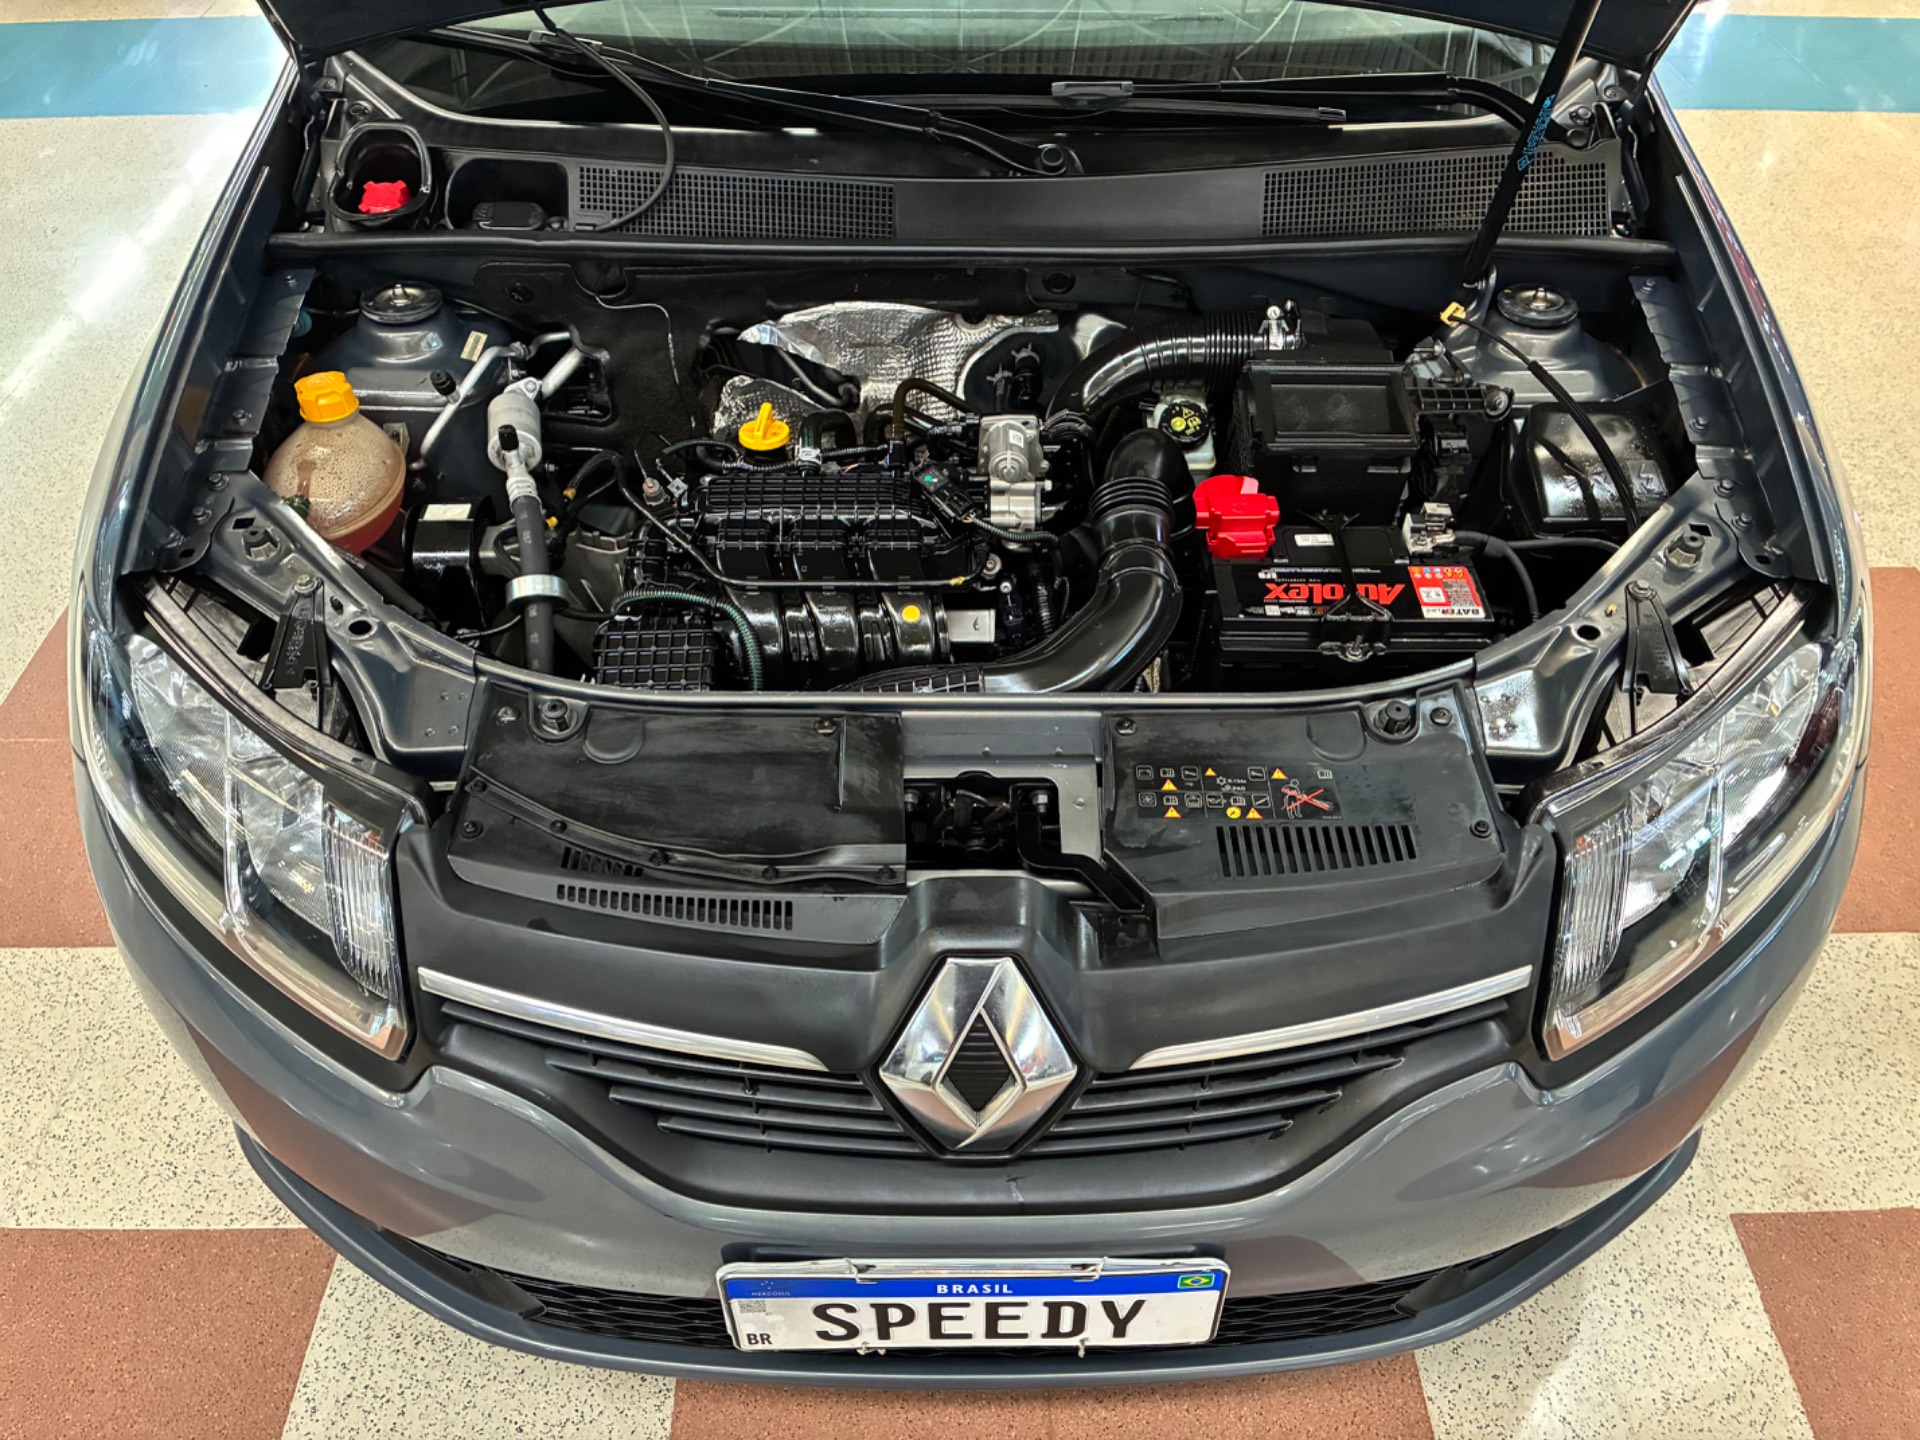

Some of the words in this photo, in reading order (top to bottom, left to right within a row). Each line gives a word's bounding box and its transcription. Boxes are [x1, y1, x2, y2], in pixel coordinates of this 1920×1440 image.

[937, 1283, 1013, 1295] BRASIL
[812, 1299, 1147, 1343] SPEEDY
[745, 1332, 773, 1345] BR
